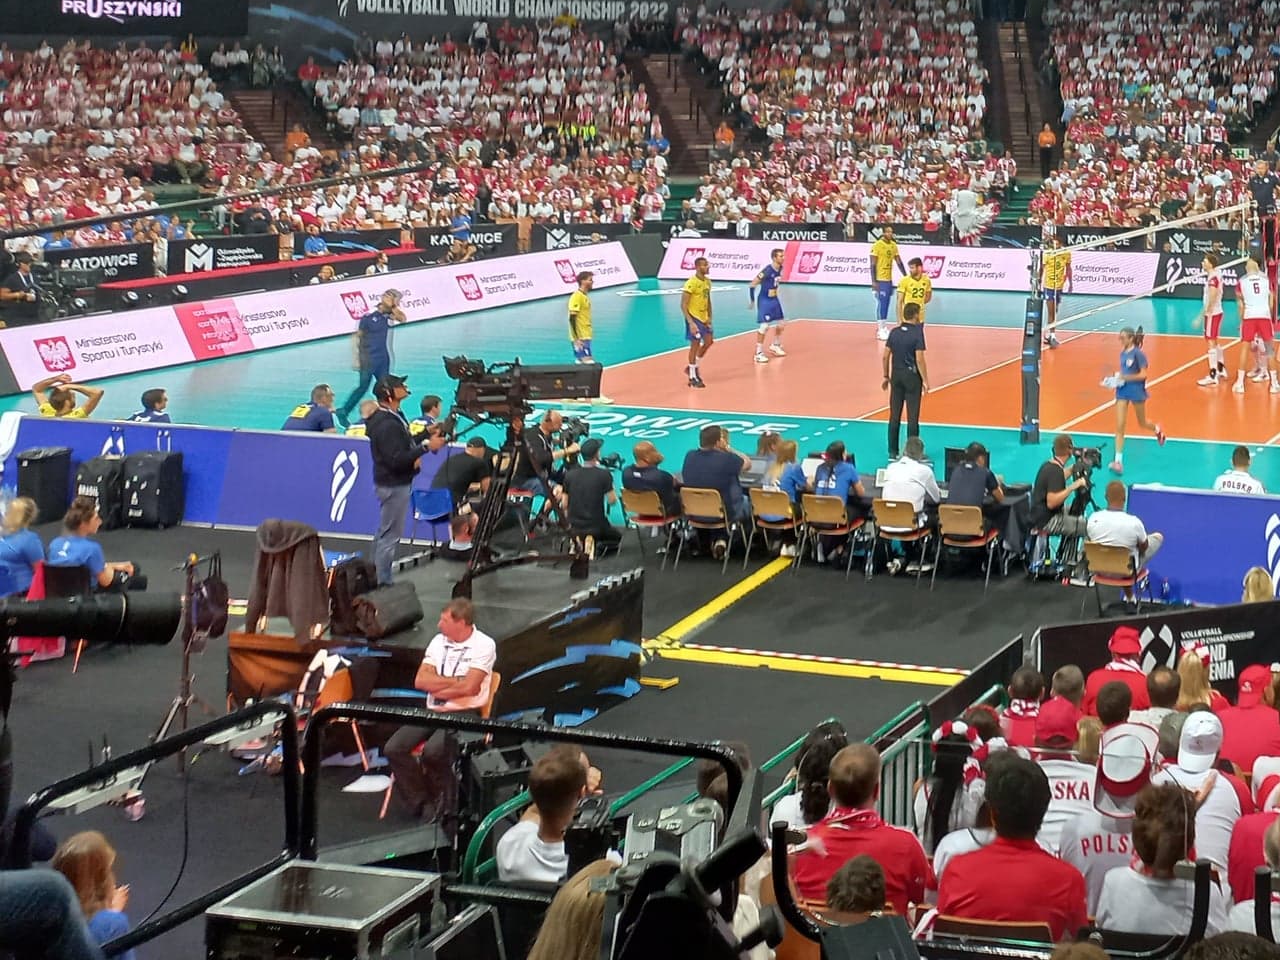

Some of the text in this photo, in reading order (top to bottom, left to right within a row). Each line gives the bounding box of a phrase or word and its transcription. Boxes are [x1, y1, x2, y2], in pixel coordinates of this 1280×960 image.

[630, 2, 669, 21] 2022
[430, 232, 503, 246] KATWICE
[762, 230, 828, 241] KATOWICE
[826, 255, 868, 264] Ministerstwo
[948, 260, 992, 269] Ministerstwo
[823, 264, 844, 274] Sportu
[946, 269, 970, 279] Sportu
[974, 269, 1006, 280] Turystyki
[911, 287, 925, 299] 23
[1253, 282, 1260, 295] 6
[274, 317, 310, 332] Turystyki
[75, 331, 137, 349] Ministerstwo
[81, 349, 115, 364] Sportu
[121, 341, 164, 359] Turystyki
[1222, 479, 1252, 494] POLSKA
[1180, 627, 1222, 640] VOLLEYBALL
[1081, 832, 1138, 857] POLS
